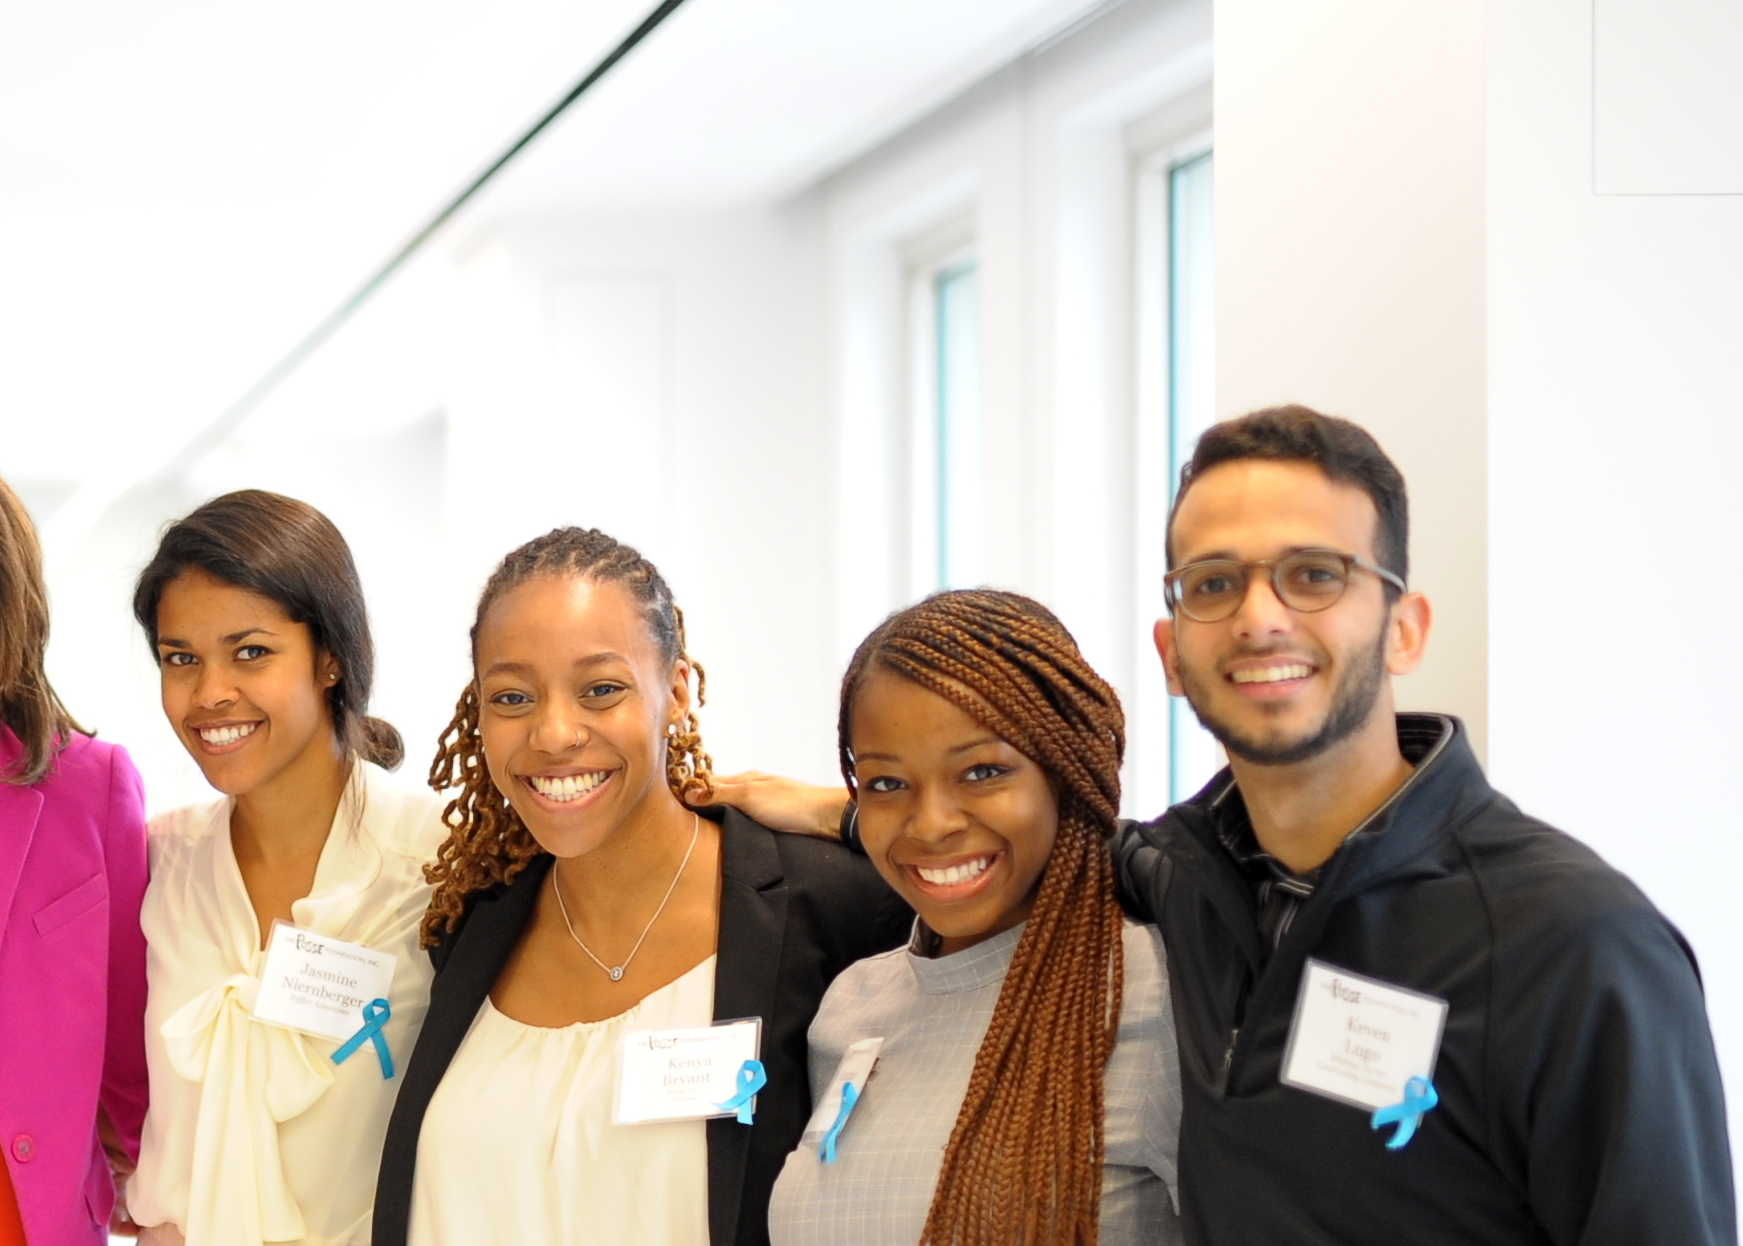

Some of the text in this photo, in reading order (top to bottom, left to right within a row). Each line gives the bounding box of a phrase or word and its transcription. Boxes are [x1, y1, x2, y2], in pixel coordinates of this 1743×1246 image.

[296, 933, 324, 955] POSSE
[300, 963, 358, 989] Jasmine
[281, 975, 365, 1008] Niernberger
[1347, 1015, 1391, 1043] Keven
[1344, 1038, 1381, 1062] Lugo
[668, 1056, 712, 1072] Kenya
[662, 1072, 710, 1087] Bryant
